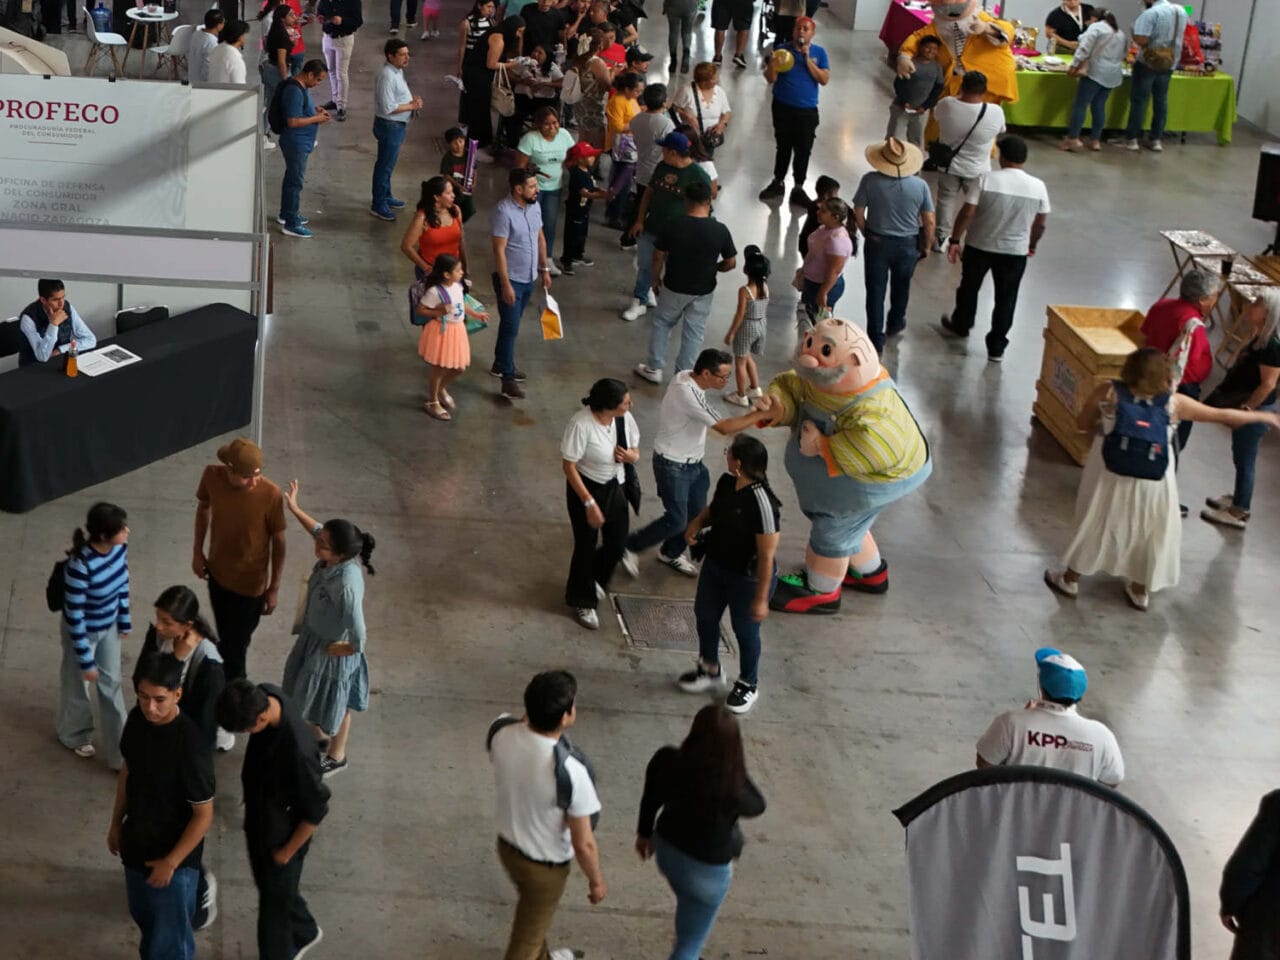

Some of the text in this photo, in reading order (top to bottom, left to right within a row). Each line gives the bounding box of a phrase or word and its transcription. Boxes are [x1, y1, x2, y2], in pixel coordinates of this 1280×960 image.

[9, 123, 64, 132] PROCURADURÍA
[36, 131, 83, 139] CONSUMIDOR
[41, 179, 55, 188] DE
[57, 180, 105, 192] DEFENSA
[3, 188, 97, 201] DEL CONSUMIDOR
[12, 200, 47, 211] ZONA
[1028, 730, 1068, 749] KPP
